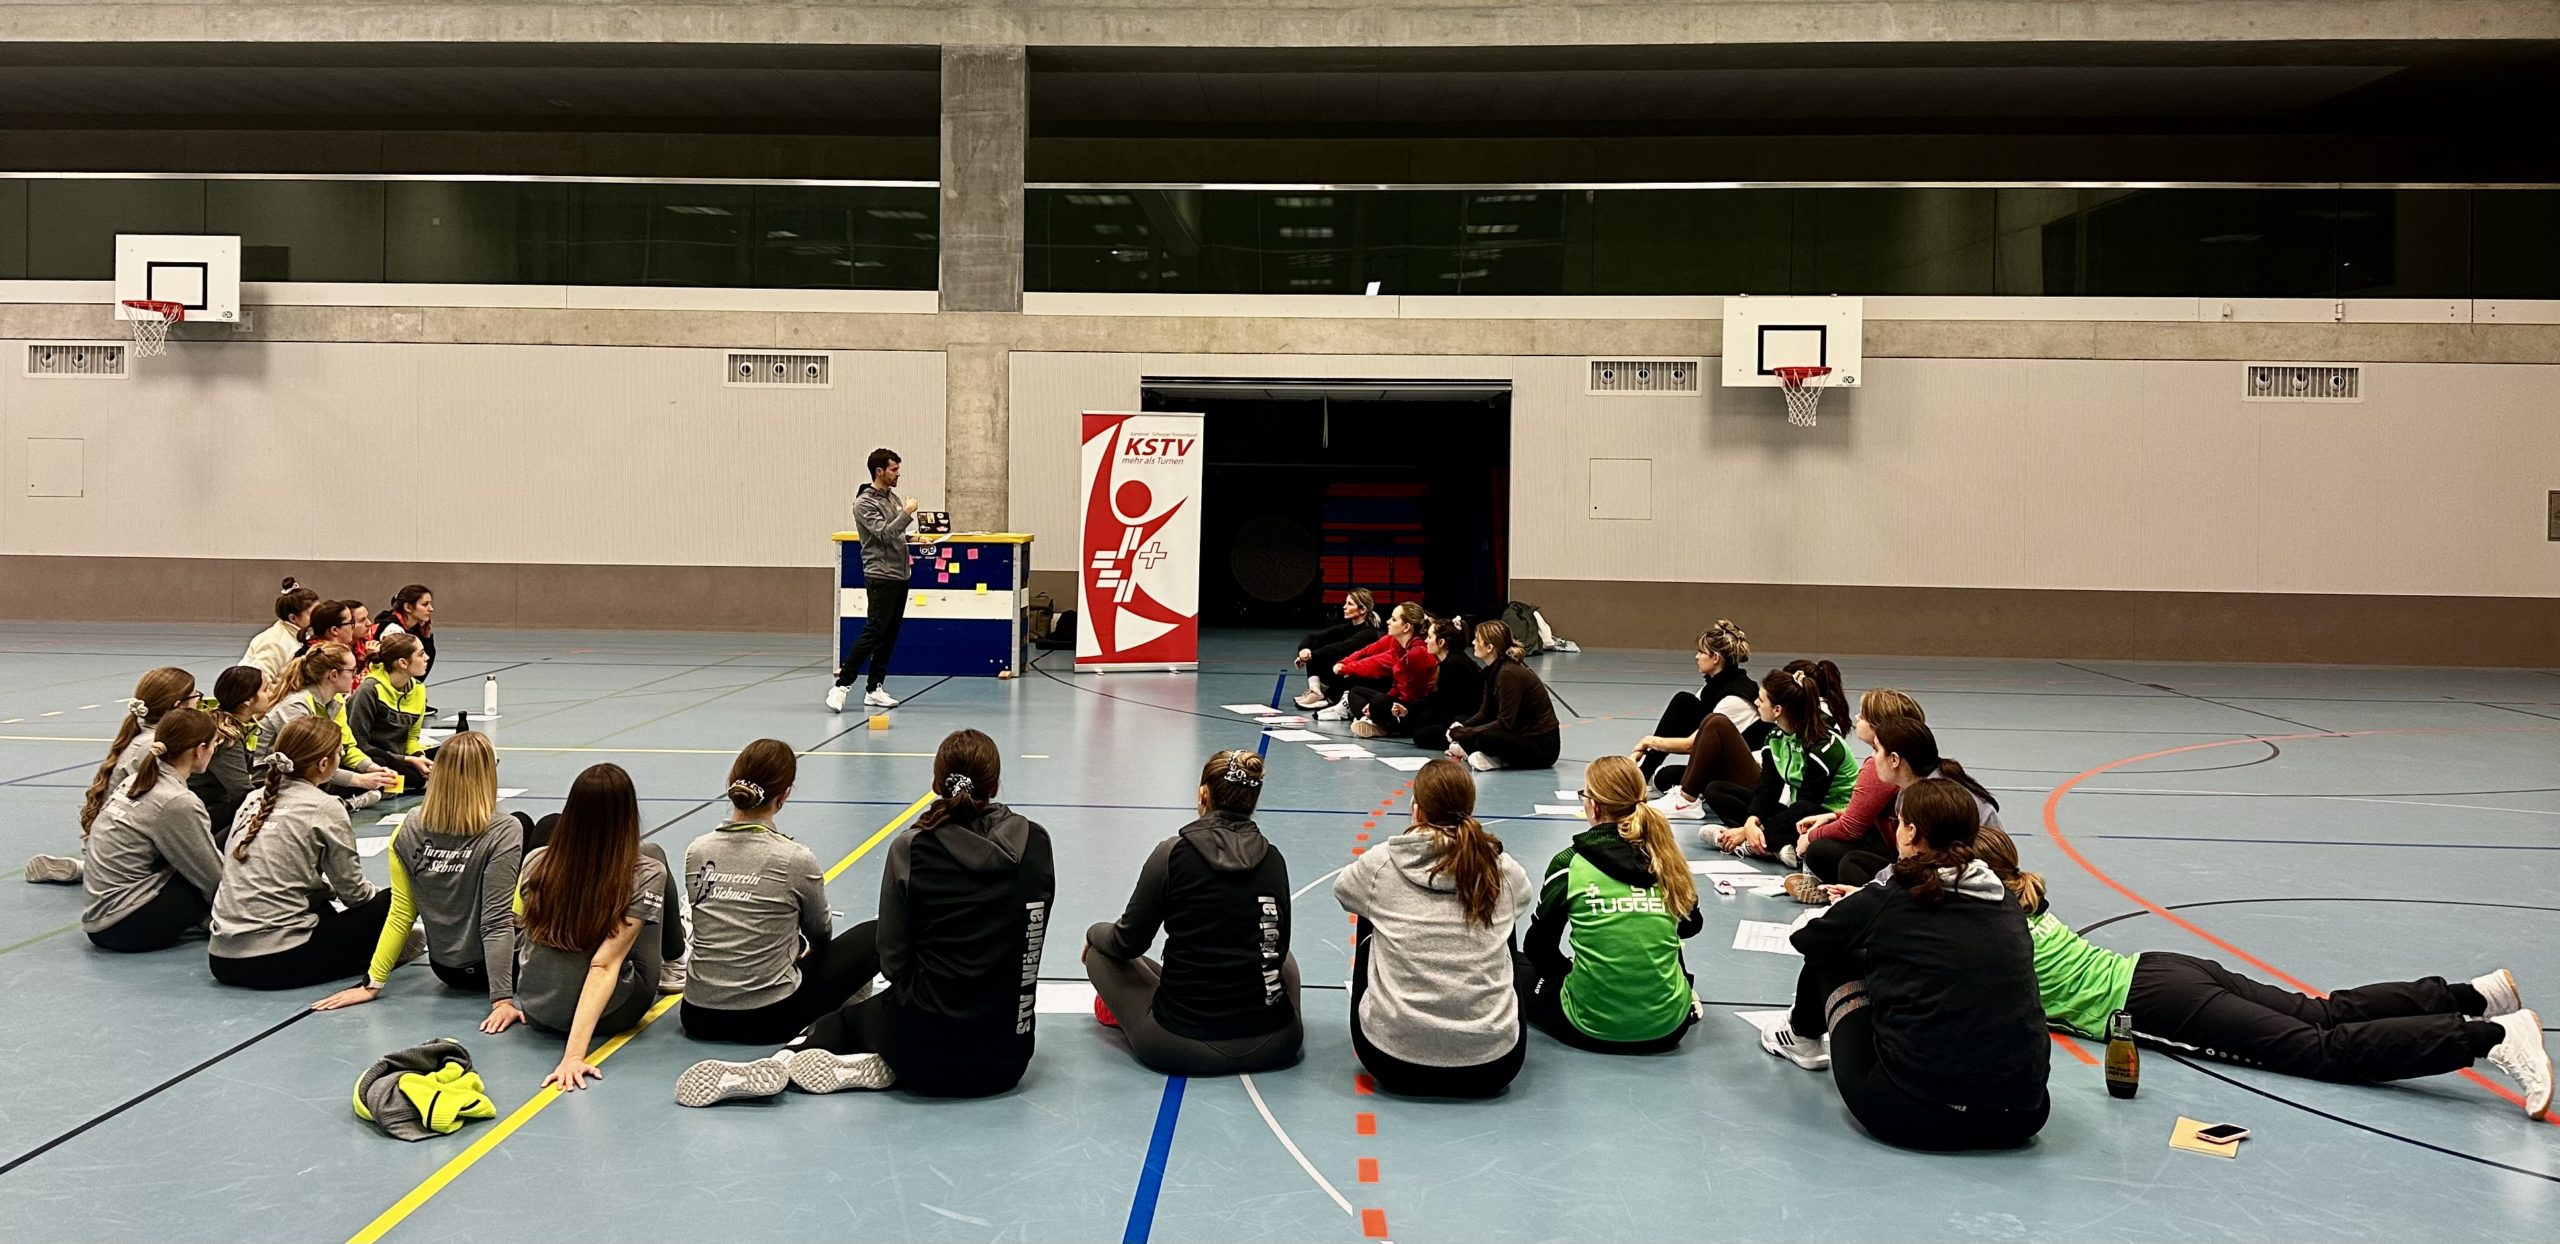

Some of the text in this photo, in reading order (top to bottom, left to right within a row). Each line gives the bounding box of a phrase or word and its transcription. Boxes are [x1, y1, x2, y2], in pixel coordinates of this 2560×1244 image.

[1124, 438, 1195, 457] KSTV
[1121, 457, 1184, 465] mehr als Turnen
[702, 868, 761, 885] Turnverein
[709, 886, 753, 901] Siebnen
[1585, 897, 1666, 916] TUGGE
[1016, 901, 1045, 1035] STV Wägital
[1262, 969, 1283, 1006] STV
